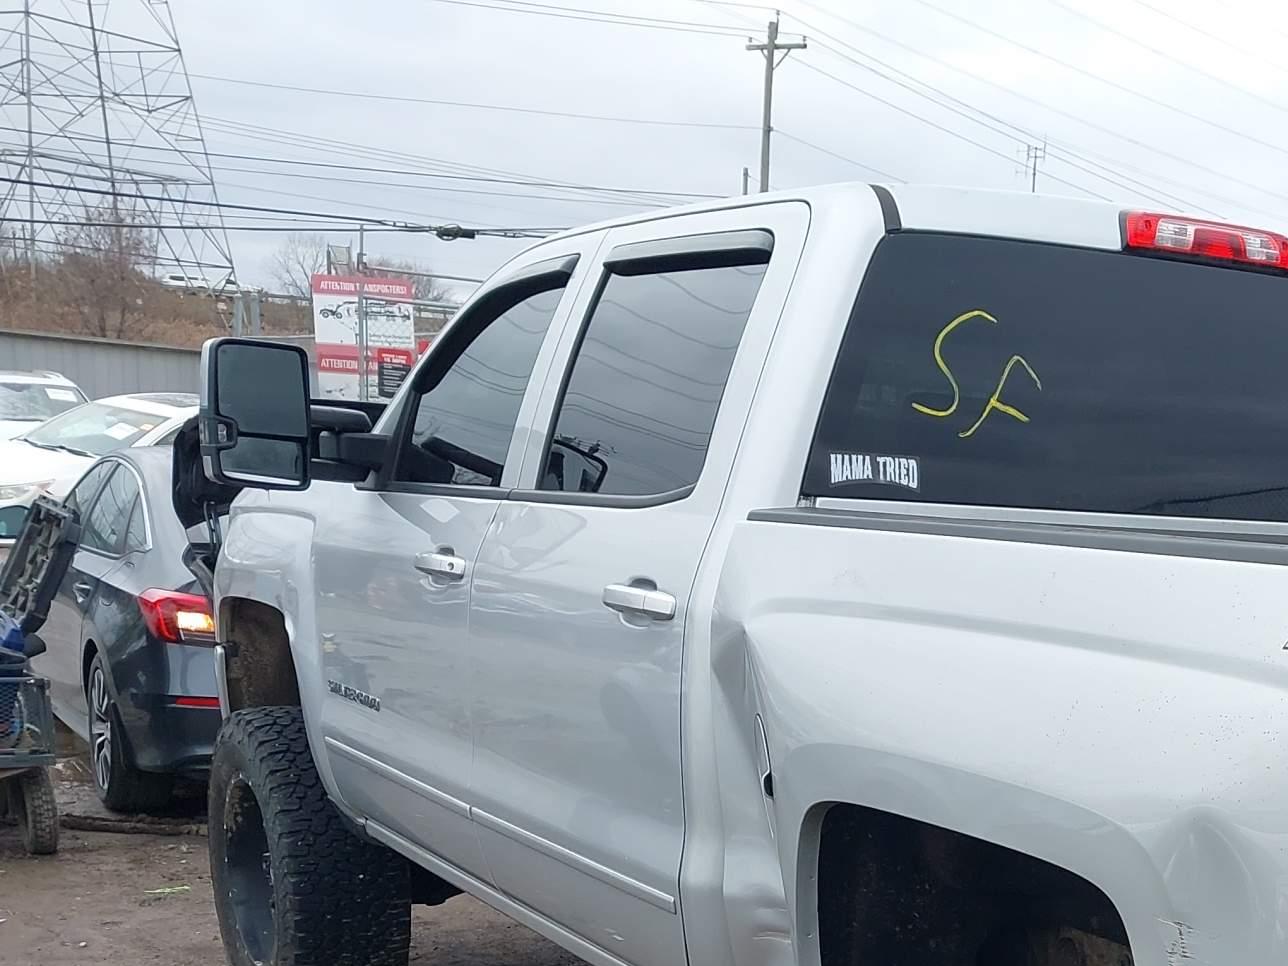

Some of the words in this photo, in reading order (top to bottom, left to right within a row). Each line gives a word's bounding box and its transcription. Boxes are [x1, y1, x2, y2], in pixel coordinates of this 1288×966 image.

[355, 282, 408, 295] TANSPORTERS!
[320, 358, 358, 370] ATTENTION
[830, 453, 873, 483] MAMA
[876, 456, 918, 488] TRIED
